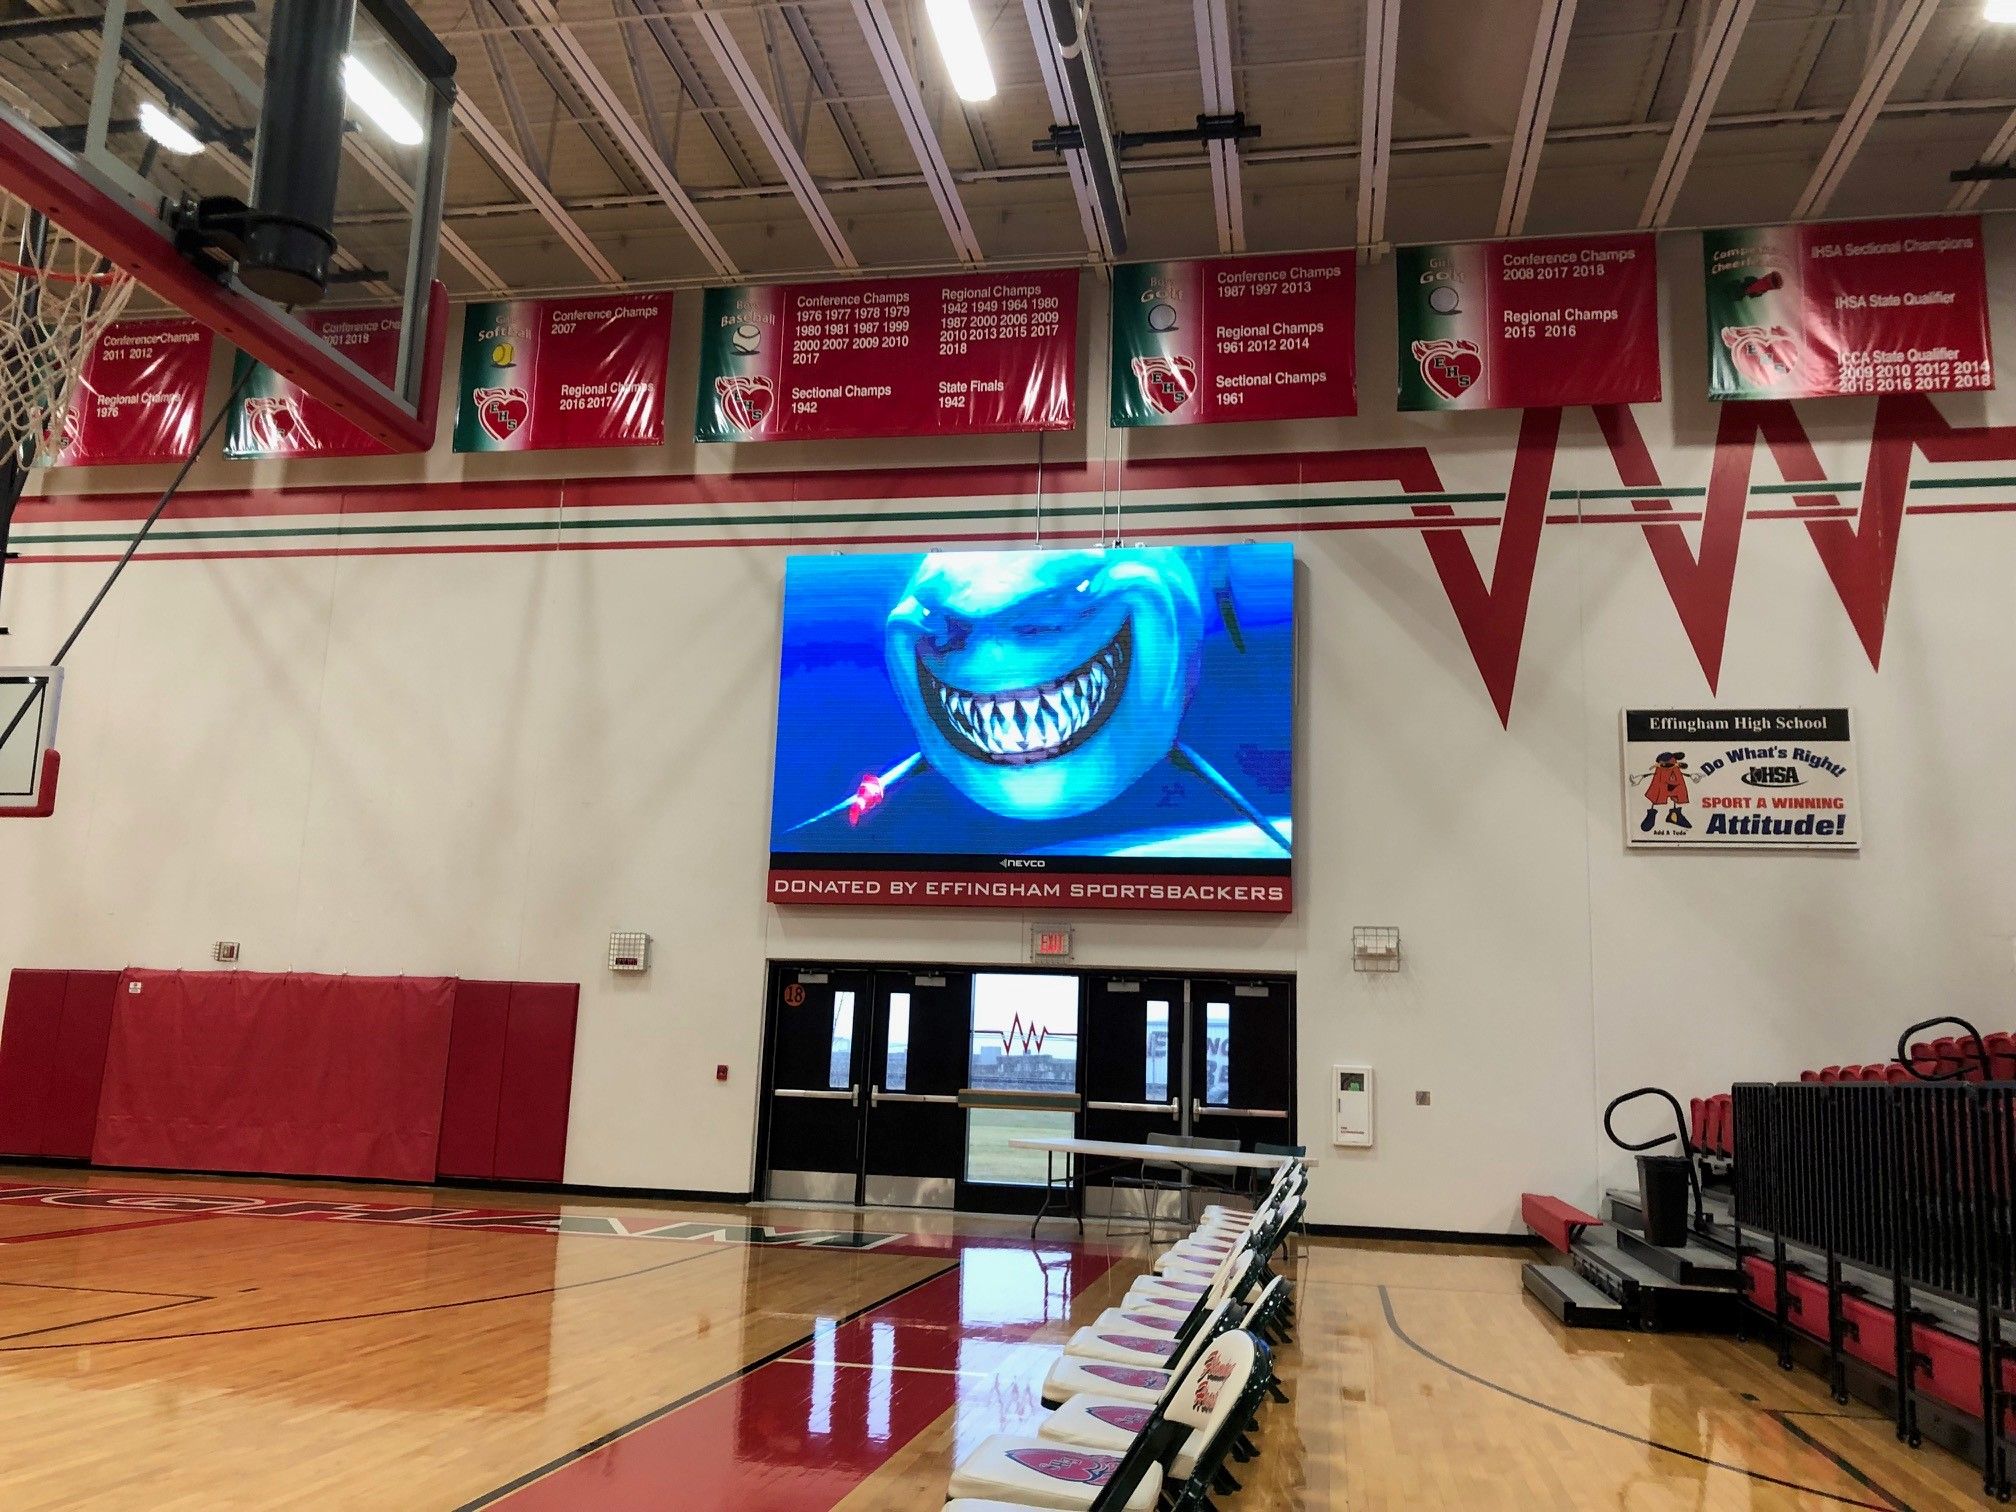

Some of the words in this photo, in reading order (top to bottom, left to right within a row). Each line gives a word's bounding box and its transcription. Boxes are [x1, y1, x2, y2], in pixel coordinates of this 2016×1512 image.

[1844, 241, 1901, 256] Sectional
[1904, 237, 1974, 253] Champions
[1503, 253, 1578, 267] Conference
[1580, 248, 1636, 263] Champs
[1217, 270, 1286, 284] Conference
[1290, 265, 1341, 281] Champs
[1503, 268, 1534, 281] 2008
[1537, 266, 1568, 280] 2017
[1572, 264, 1605, 277] 2018
[942, 287, 991, 301] Regional
[993, 285, 1041, 298] Champs
[1218, 286, 1246, 298] 1987
[1249, 284, 1278, 296] 1997
[1281, 282, 1312, 294] 2013
[797, 295, 861, 307] Conference
[863, 292, 910, 305] Champs
[942, 302, 968, 314] 1942
[972, 301, 998, 313] 1949
[1001, 299, 1028, 311] 1964
[1031, 297, 1059, 310] 1980
[1835, 295, 1867, 309] IHSA
[1869, 294, 1901, 308] State
[1903, 290, 1956, 306] Qualifier
[553, 308, 612, 322] Conference
[615, 306, 658, 319] Champs
[797, 310, 822, 322] 1976
[825, 309, 851, 321] 1977
[854, 307, 880, 319] 1978
[884, 305, 910, 318] 1979
[941, 317, 967, 329] 1987
[970, 315, 998, 327] 2000
[1000, 313, 1028, 326] 2006
[1031, 311, 1059, 324] 2009
[1504, 309, 1561, 324] Regional
[1565, 308, 1619, 322] Champs
[323, 322, 379, 333] Conference
[551, 324, 576, 335] 2007
[796, 325, 821, 336] 1980
[824, 324, 849, 335] 1981
[854, 322, 879, 334] 1987
[883, 320, 910, 333] 1999
[940, 330, 967, 342] 2010
[969, 327, 997, 340] 2013
[999, 326, 1027, 339] 2015
[1031, 324, 1059, 337] 2017
[1216, 325, 1270, 340] Regional
[1272, 321, 1324, 336] Champs
[1504, 325, 1536, 339] 2015
[1544, 324, 1576, 338] 2016
[103, 335, 157, 346] Conference
[160, 332, 199, 343] Champs
[793, 340, 820, 352] 2000
[822, 338, 849, 350] 2007
[852, 336, 879, 349] 2009
[882, 335, 909, 348] 2010
[1216, 341, 1244, 353] 1961
[1247, 339, 1277, 352] 2012
[1279, 337, 1309, 351] 2014
[103, 349, 124, 360] 2011
[130, 348, 153, 359] 2012
[939, 343, 967, 355] 2018
[1873, 350, 1905, 363] State
[1907, 347, 1960, 362] Qualifier
[793, 353, 820, 365] 2017
[1434, 356, 1471, 388] EHS
[1876, 364, 1911, 377] 2010
[1915, 362, 1950, 376] 2012
[1953, 359, 1990, 374] 2014
[938, 380, 968, 393] State
[970, 379, 1004, 392] Finals
[1151, 372, 1185, 403] EHS
[1216, 374, 1272, 388] Sectional
[1275, 371, 1327, 386] Champs
[1839, 379, 1874, 392] 2015
[1877, 378, 1912, 391] 2016
[1915, 377, 1950, 390] 2017
[1954, 374, 1991, 388] 2018
[561, 383, 607, 397] Regional
[792, 386, 842, 400] Sectional
[845, 384, 892, 399] Champs
[98, 393, 139, 406] Regional
[560, 399, 586, 410] 2016
[587, 397, 612, 409] 2017
[938, 396, 966, 409] 1942
[1216, 392, 1244, 405] 1961
[97, 407, 119, 417] 1976
[791, 401, 818, 414] 1942
[1650, 717, 1729, 732] Effingham
[1734, 717, 1771, 731] High
[1776, 716, 1827, 730] School
[1700, 759, 1724, 777] Do
[1726, 746, 1788, 764] What's
[1792, 747, 1847, 778] Right!
[1702, 797, 1752, 809] SPORT
[1756, 797, 1767, 809] A
[1772, 797, 1845, 810] WINNING
[1706, 813, 1847, 836] Attitude!
[1007, 859, 1046, 868] NEVCO
[774, 879, 882, 895] DONATED
[890, 881, 921, 896] BY
[926, 881, 1061, 898] EFFINGHAM
[1070, 883, 1284, 902] SPORTSBACKERS
[1041, 932, 1063, 952] EXIT
